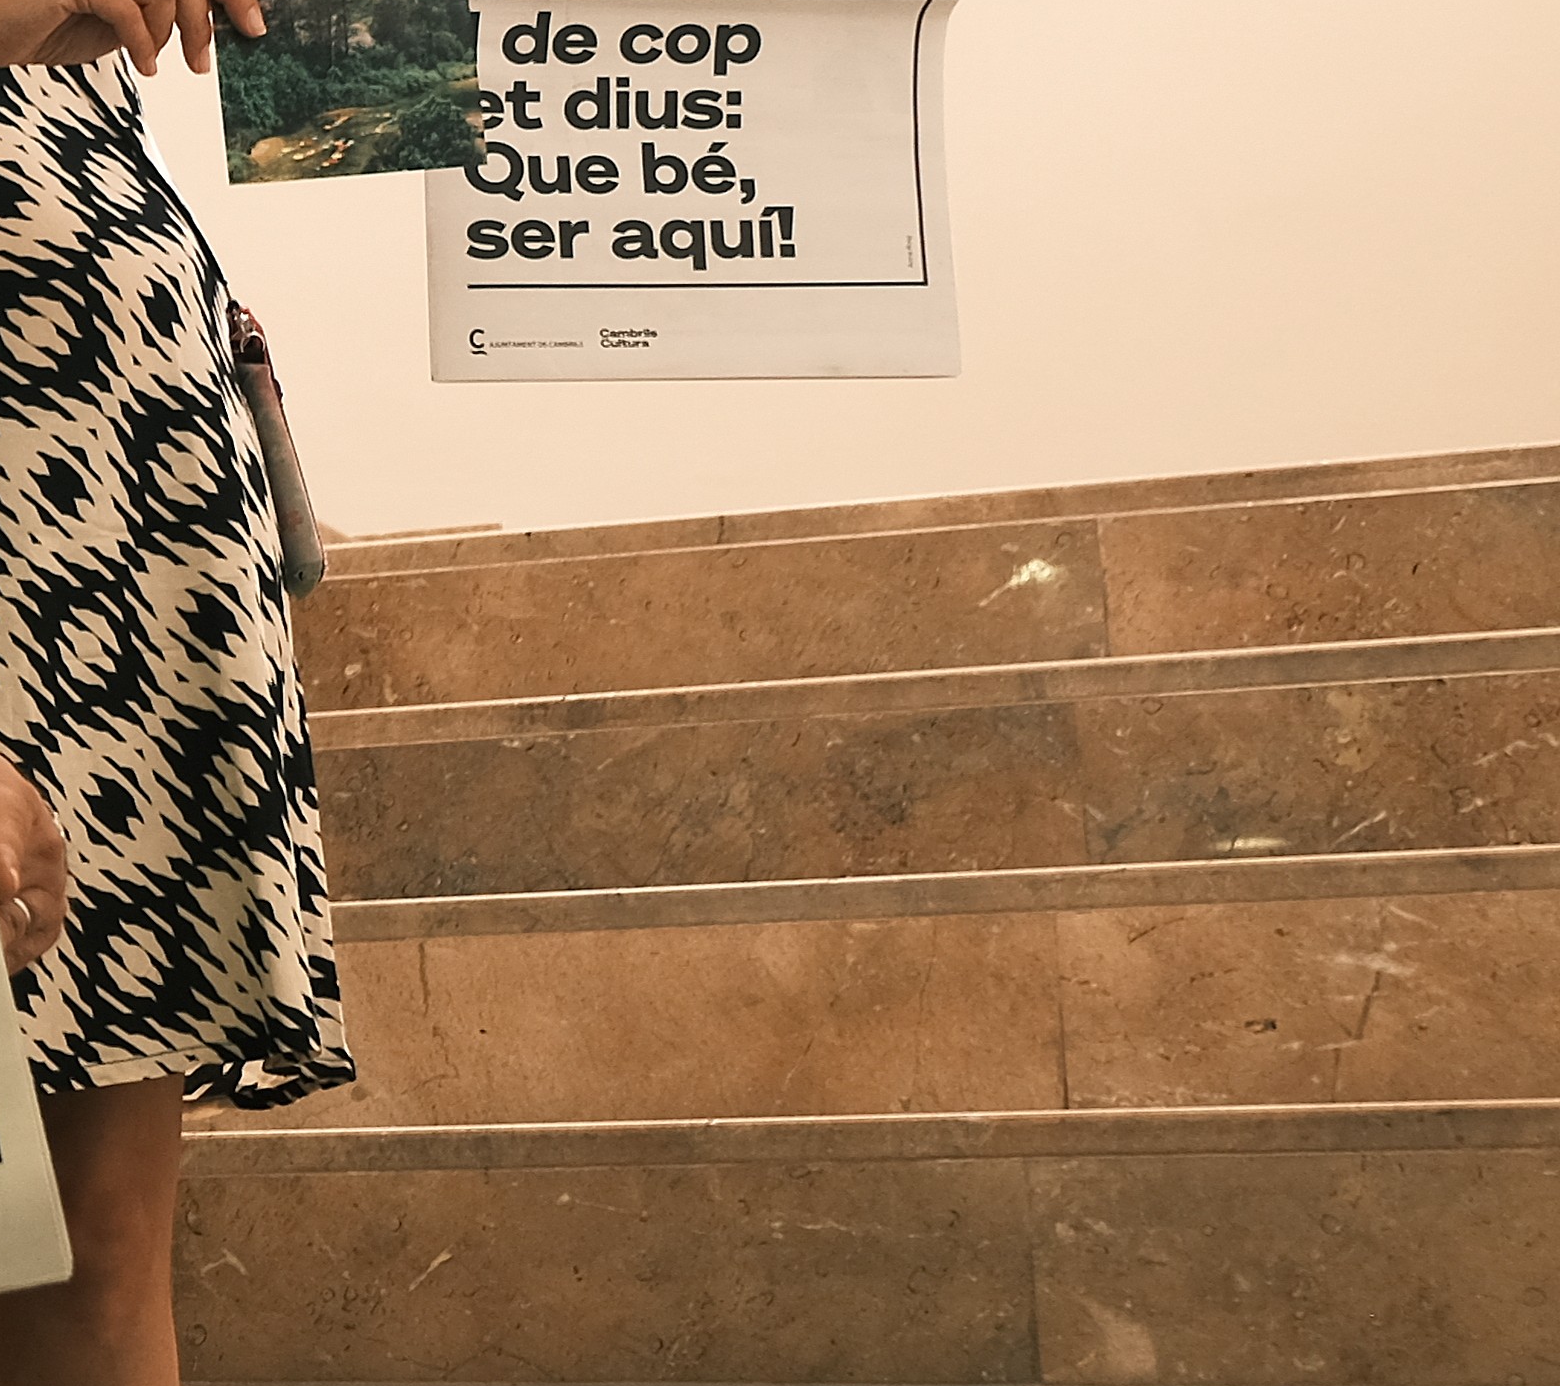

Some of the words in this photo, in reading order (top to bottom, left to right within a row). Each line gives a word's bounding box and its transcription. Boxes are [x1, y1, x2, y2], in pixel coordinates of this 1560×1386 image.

[502, 11, 598, 64] de
[620, 24, 761, 76] cop
[564, 77, 742, 130] dius:
[464, 141, 619, 201] Que
[641, 142, 756, 204] bé,
[467, 220, 590, 260] ser
[612, 206, 796, 271] aquí!
[599, 328, 658, 338] Cambrils
[600, 339, 650, 348] Cultura
